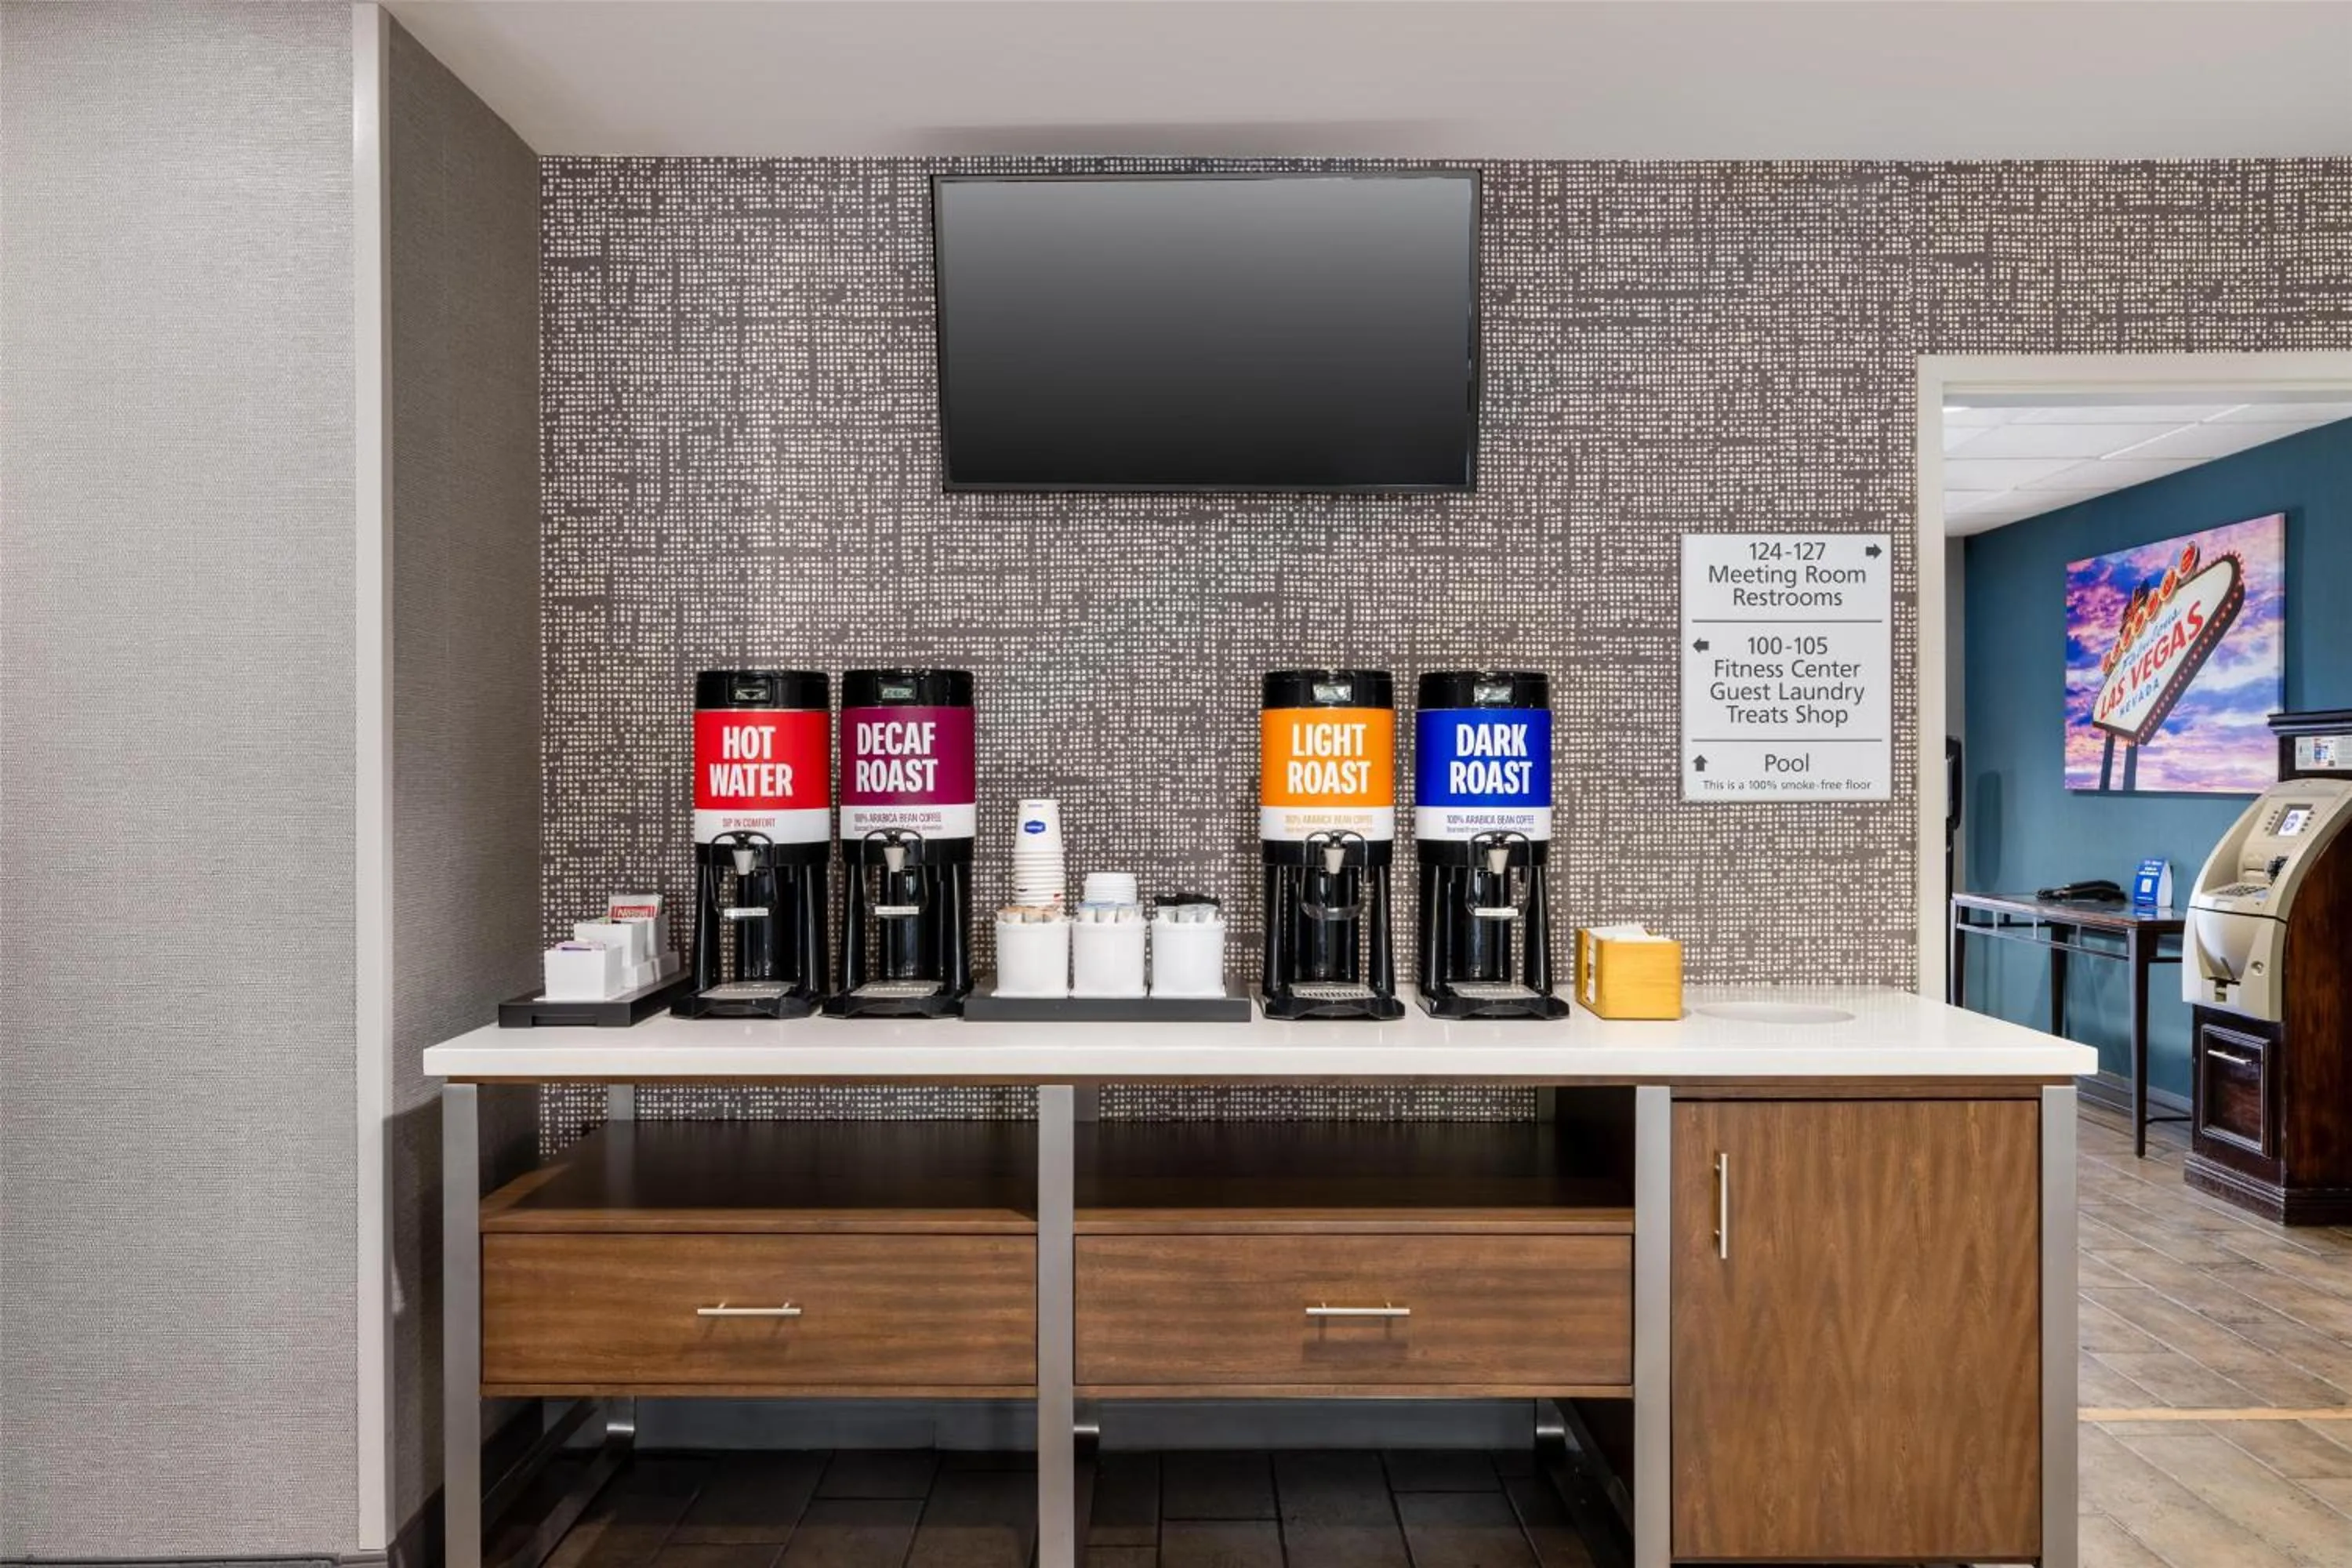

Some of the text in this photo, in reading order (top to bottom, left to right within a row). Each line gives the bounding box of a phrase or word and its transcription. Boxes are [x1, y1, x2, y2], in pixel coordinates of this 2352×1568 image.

[1749, 542, 1826, 561] 124-127
[1709, 564, 1867, 588] Meeting Room
[1733, 588, 1843, 607] Restrooms
[1748, 636, 1828, 655] 100-105
[1714, 659, 1861, 678] Fitness Center
[2100, 676, 2125, 720] LAS
[2131, 599, 2204, 691] VEGAS
[1710, 681, 1865, 706] Guest Laundry
[1726, 704, 1849, 728] Treats Shop
[723, 726, 776, 760] HOT
[856, 721, 937, 756] DECAF
[1292, 723, 1367, 757] LIGHT
[1456, 724, 1529, 757] DARK
[1765, 753, 1809, 773] Pool
[710, 764, 793, 797] WATER
[856, 759, 938, 793] ROAST
[1287, 760, 1371, 794] ROAST
[1450, 760, 1533, 794] ROAST
[1703, 779, 1725, 790] This
[1727, 780, 1736, 790] is
[1738, 782, 1744, 790] a
[1748, 779, 1777, 790] 100%
[1845, 779, 1872, 790] floor
[1465, 815, 1496, 825] ARABICA
[1497, 815, 1515, 824] BEAN
[1515, 815, 1534, 824] COFFEE
